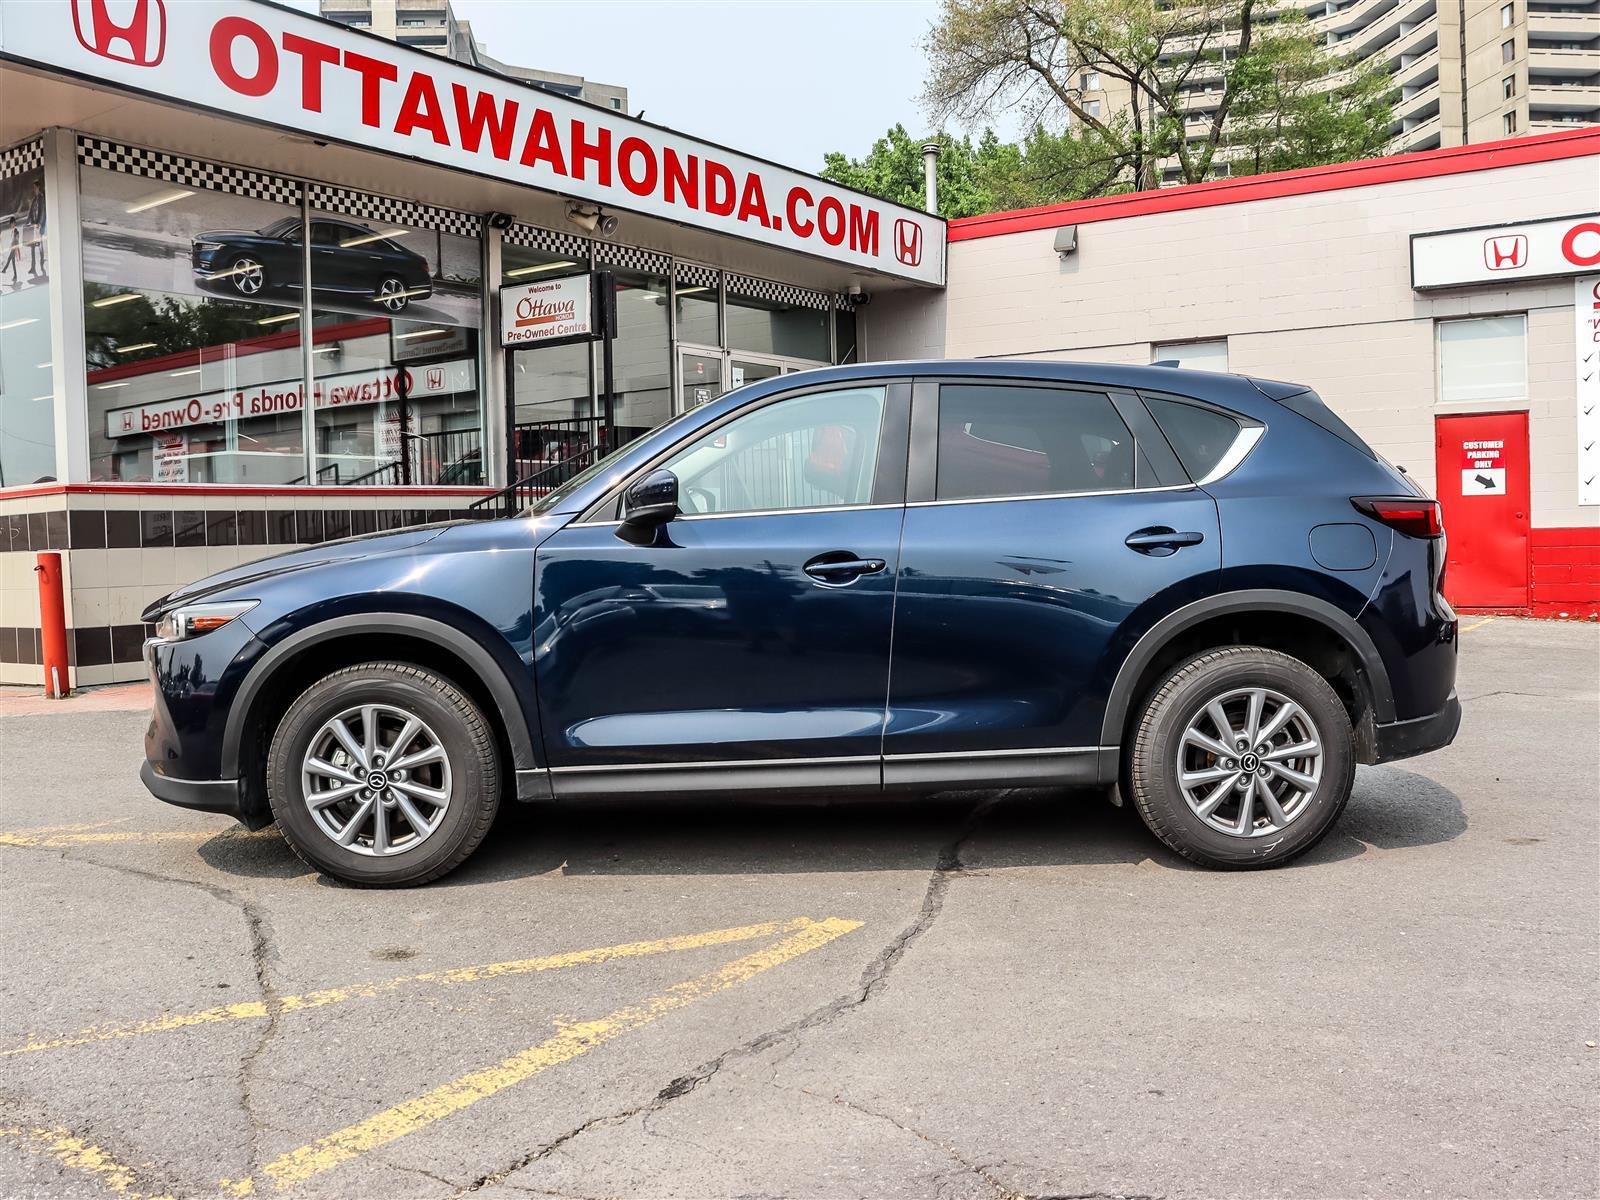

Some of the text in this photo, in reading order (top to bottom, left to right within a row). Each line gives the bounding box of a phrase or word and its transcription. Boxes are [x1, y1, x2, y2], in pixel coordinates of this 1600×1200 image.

[209, 16, 880, 257] OTTAWAHONDA.COM
[528, 286, 554, 294] Welcome
[516, 297, 575, 319] Ottawa
[555, 313, 573, 321] HONDA
[507, 323, 587, 341] Pre-Owned Centre
[1463, 440, 1504, 449] CUSTOMER
[1467, 450, 1500, 459] PARKING
[1474, 460, 1493, 468] ONLY
